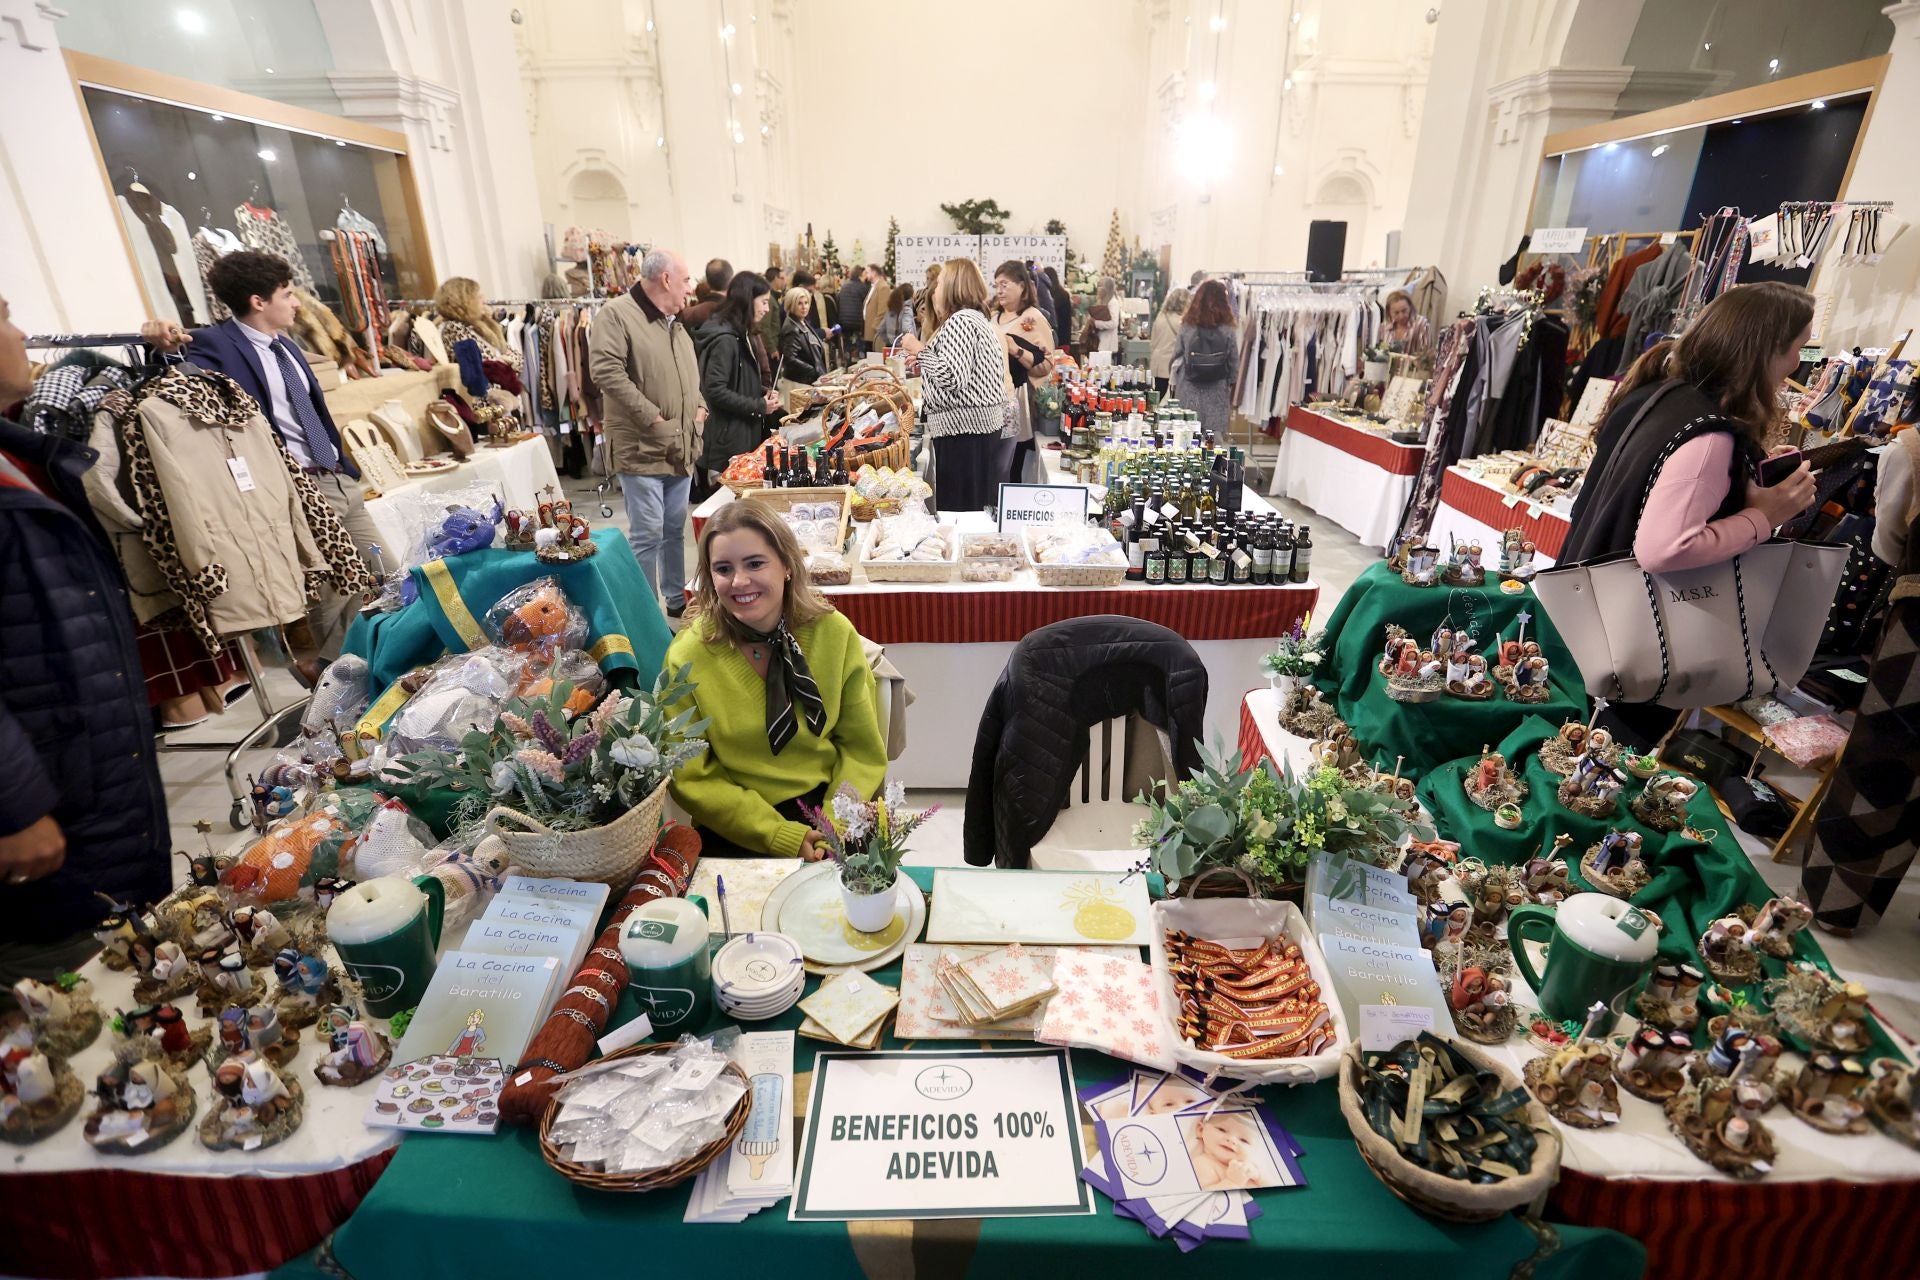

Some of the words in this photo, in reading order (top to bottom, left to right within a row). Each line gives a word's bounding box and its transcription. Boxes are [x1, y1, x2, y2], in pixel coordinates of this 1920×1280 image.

[896, 237, 961, 247] ADEVIDA
[983, 237, 1048, 247] ADEVIDA
[1006, 509, 1054, 521] BENEFICIOS
[1669, 585, 1719, 602] M.S.R.
[516, 882, 534, 892] La
[540, 884, 588, 897] Cocina
[500, 907, 518, 919] La
[523, 911, 572, 926] Cocina
[1329, 901, 1345, 914] La
[1350, 908, 1399, 926] Cocina
[484, 926, 502, 938] La
[508, 929, 560, 943] Cocina
[1338, 941, 1356, 953] La
[1361, 946, 1413, 961] Cocina
[456, 958, 476, 969] La
[482, 960, 535, 973] Cocina
[478, 974, 504, 984] del
[1348, 967, 1418, 986] Baratillo
[365, 984, 395, 995] VIDA
[448, 984, 522, 1000] Baratillo
[922, 1085, 965, 1094] ADEVIDA
[830, 1113, 979, 1141] BENEFICIOS
[993, 1111, 1055, 1138] 100%
[1119, 1133, 1140, 1179] ADEVIDA
[886, 1150, 999, 1180] ADEVIDA
